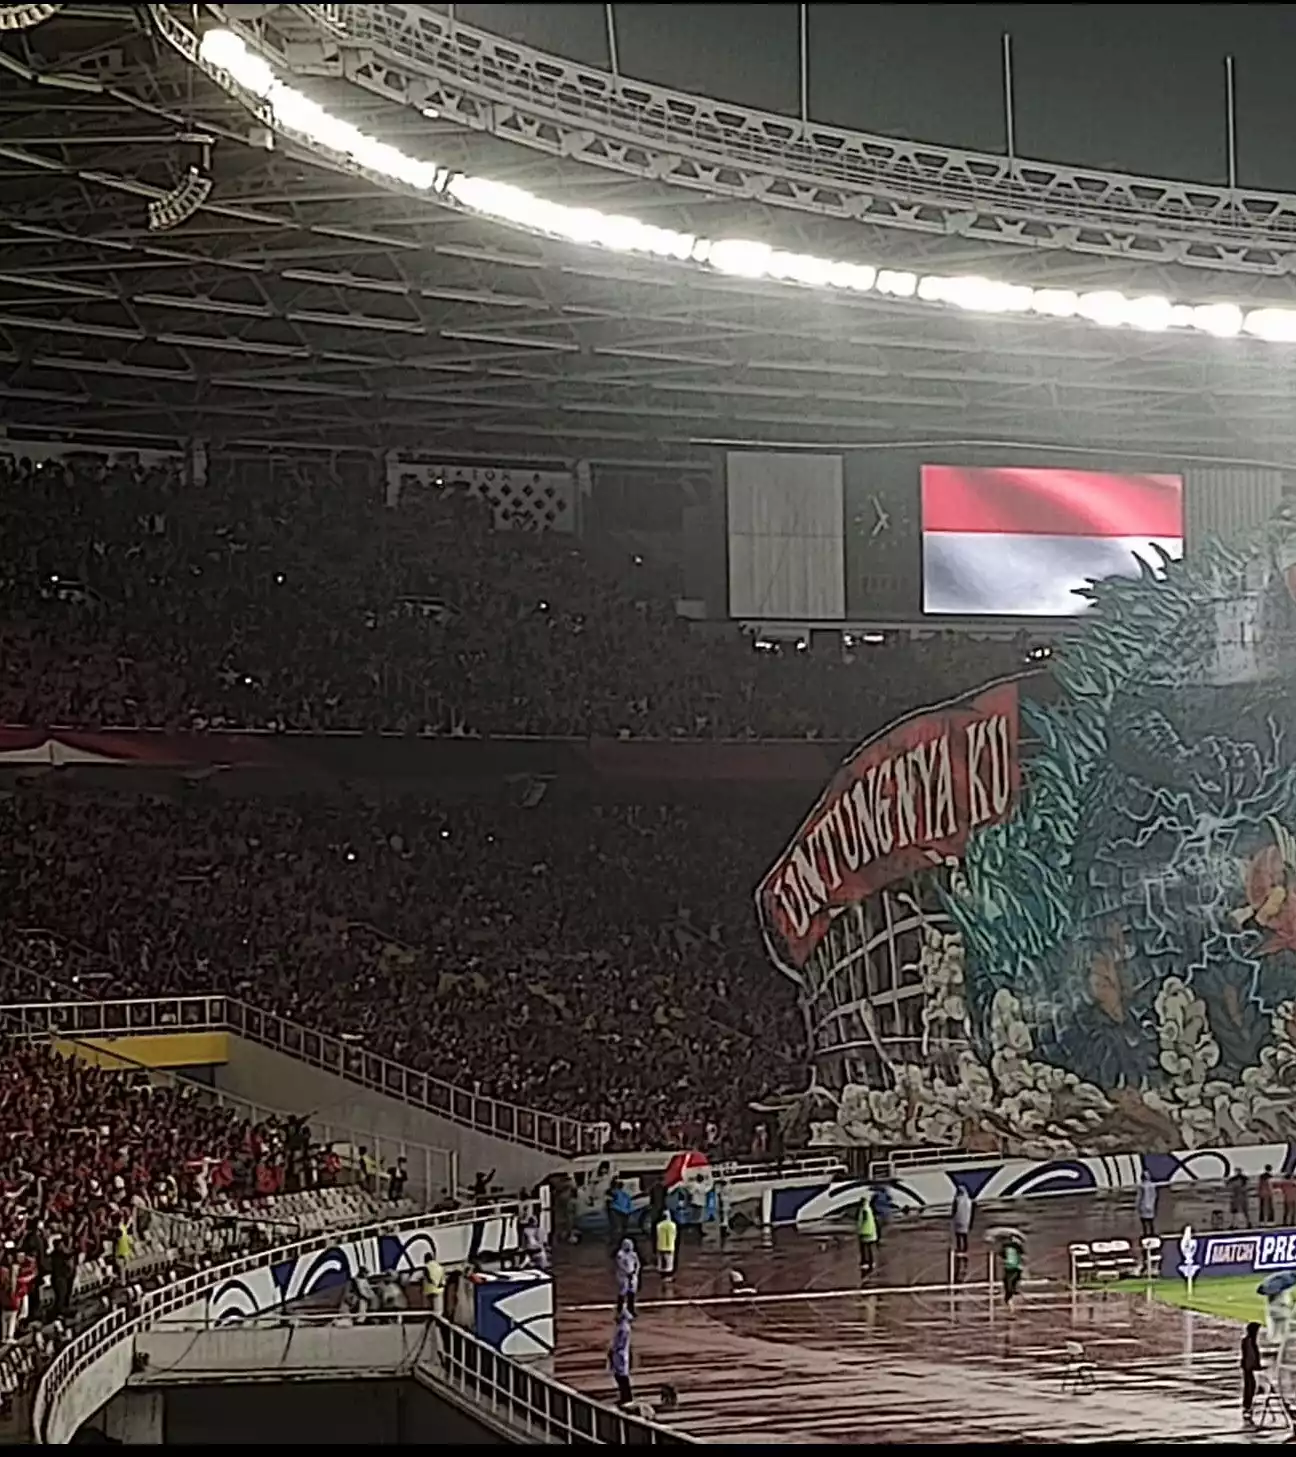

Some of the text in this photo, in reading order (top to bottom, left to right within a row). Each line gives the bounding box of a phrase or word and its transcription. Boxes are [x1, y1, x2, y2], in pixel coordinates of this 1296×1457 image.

[774, 714, 1010, 937] UNTUNGNYA KU
[1211, 1242, 1256, 1263] MATCH
